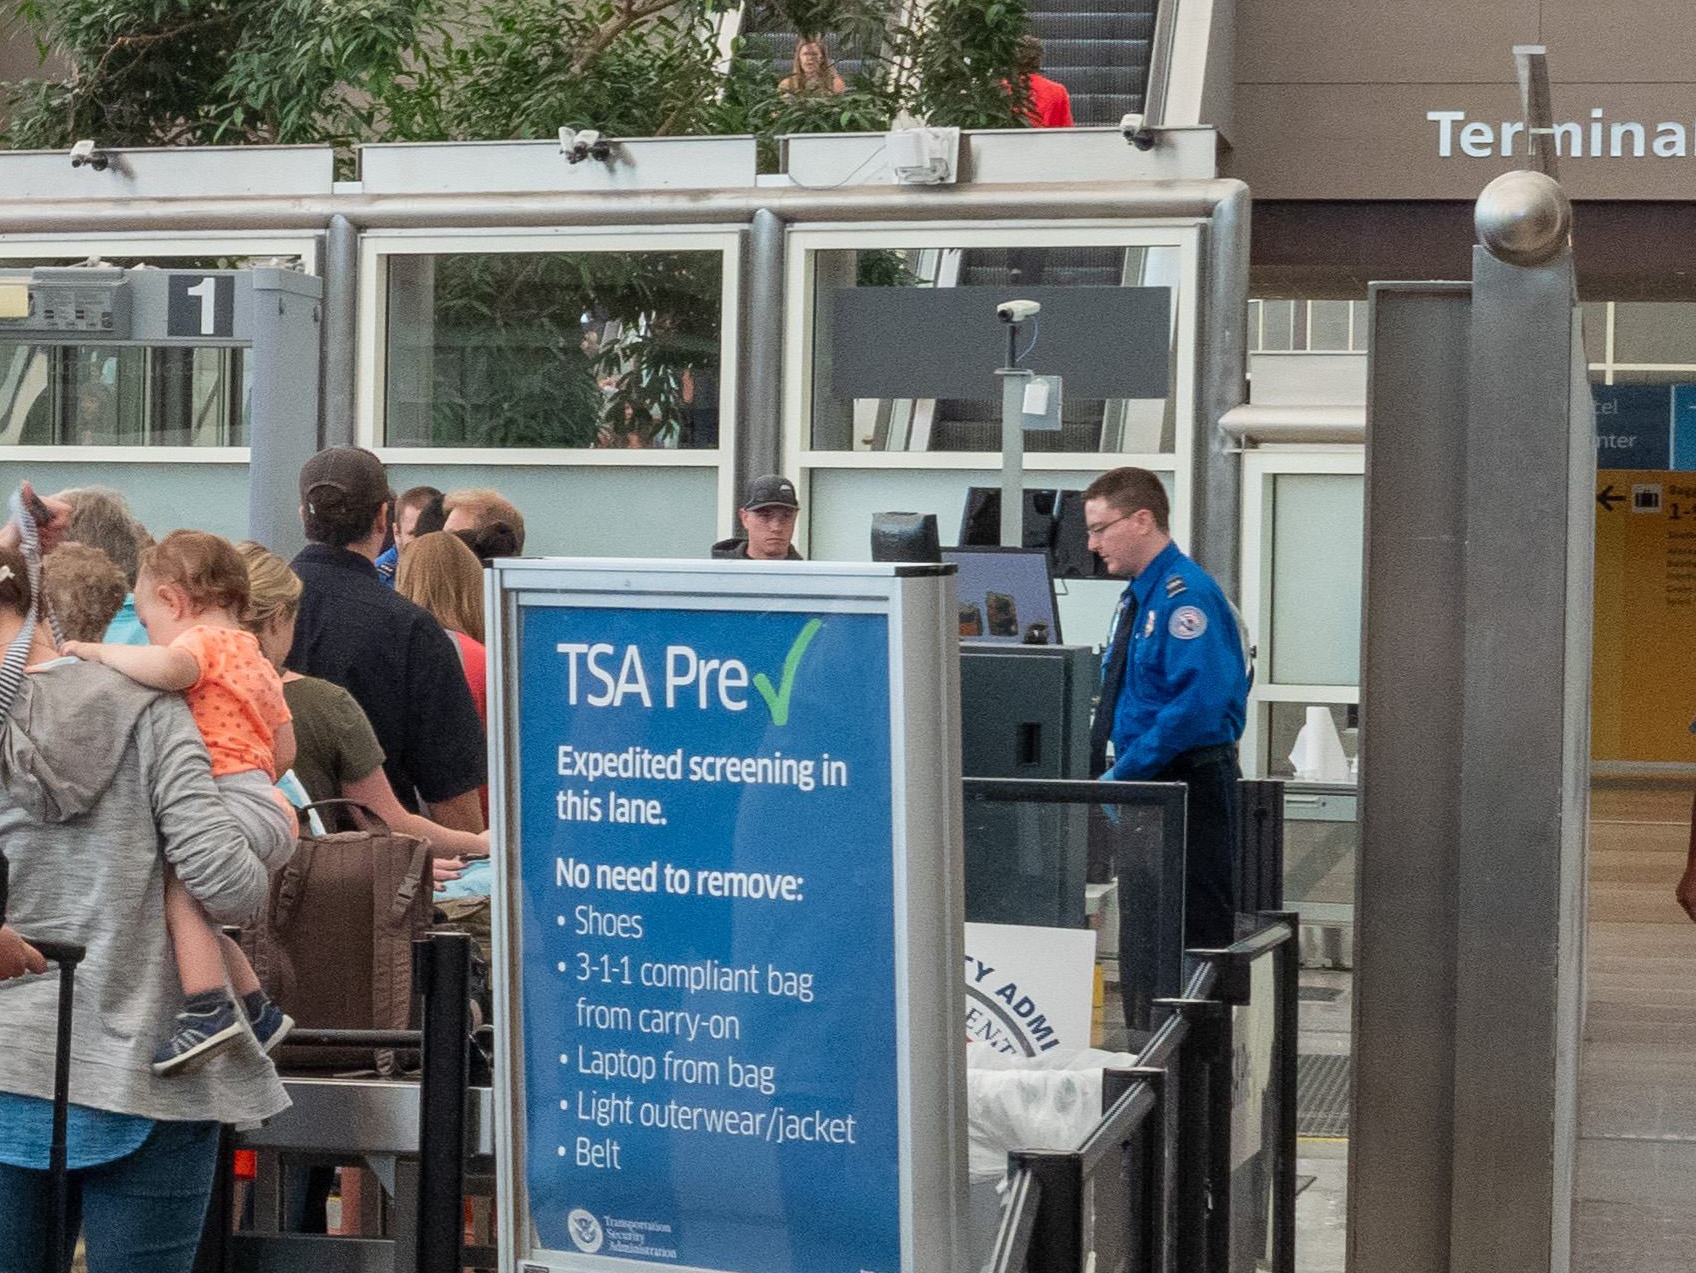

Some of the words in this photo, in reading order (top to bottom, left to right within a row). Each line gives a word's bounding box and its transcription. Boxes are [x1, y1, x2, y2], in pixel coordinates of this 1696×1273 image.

[1426, 107, 1696, 159] Termina
[187, 277, 216, 336] 1
[556, 643, 653, 708] TSA
[665, 645, 749, 711] Pre
[557, 745, 683, 782] Expedited
[689, 751, 816, 792] screening
[822, 753, 848, 787] in
[556, 789, 603, 823] this
[609, 791, 668, 825] lane.
[556, 857, 591, 890] No
[596, 861, 658, 893] need
[664, 863, 690, 895] to
[697, 873, 805, 901] remove:
[575, 904, 643, 939] Shoes
[576, 952, 633, 985] 3-1-1
[640, 959, 760, 994] compliant
[767, 964, 815, 1003] bag
[576, 997, 633, 1031] from
[638, 1008, 741, 1042] carry-on
[994, 982, 1061, 1052] ADMI
[578, 1045, 657, 1084] Laptop
[663, 1050, 720, 1085] from
[728, 1056, 776, 1095] bag
[577, 1090, 634, 1127] Light
[640, 1099, 857, 1145] outerwear/jacket
[576, 1136, 622, 1170] Belt
[603, 1215, 672, 1233] Transportation
[606, 1230, 646, 1245] Security
[609, 1241, 677, 1260] Administration
